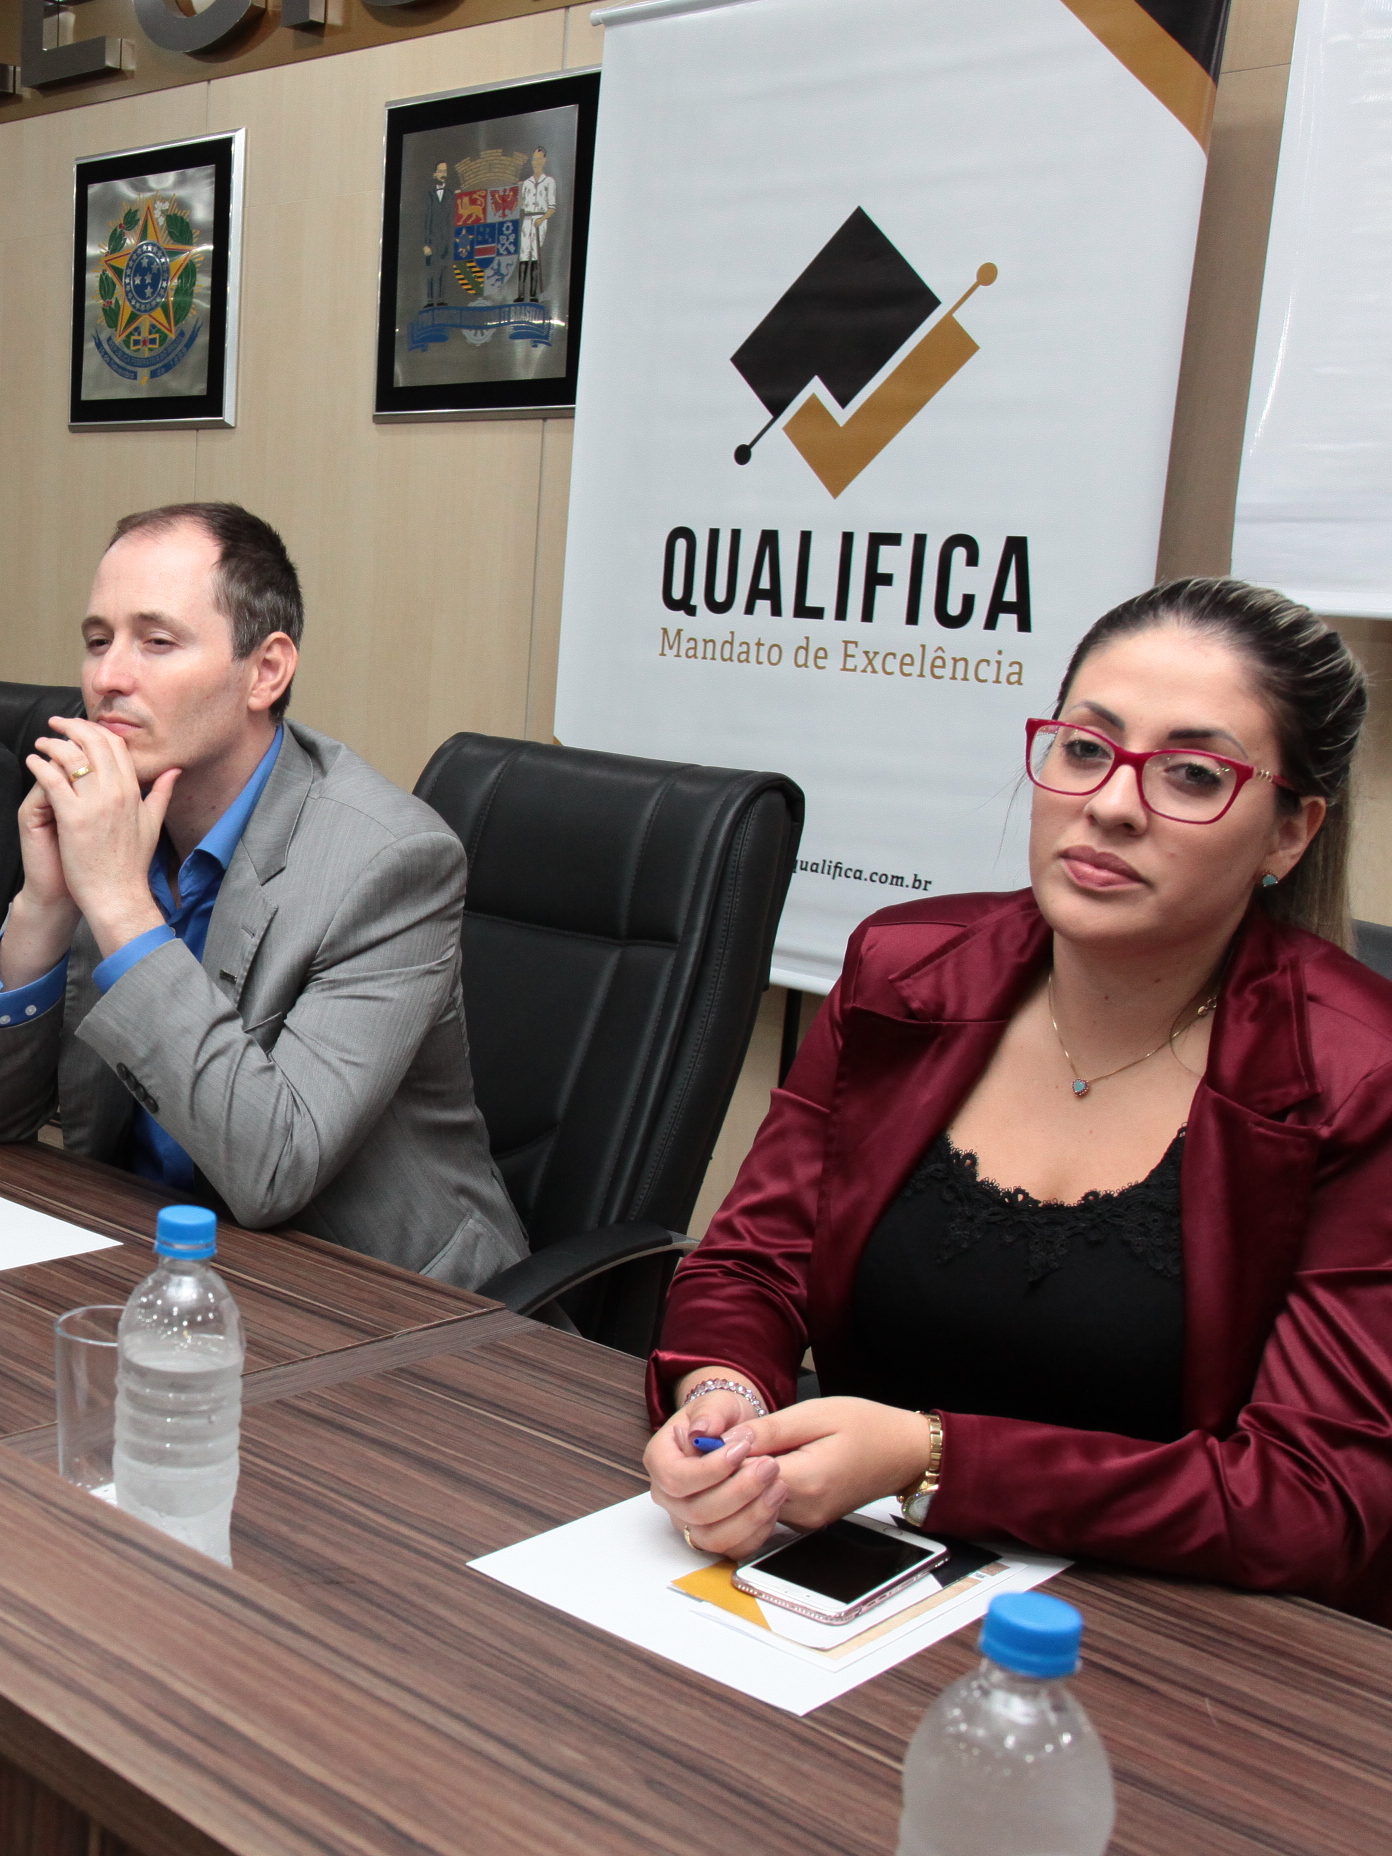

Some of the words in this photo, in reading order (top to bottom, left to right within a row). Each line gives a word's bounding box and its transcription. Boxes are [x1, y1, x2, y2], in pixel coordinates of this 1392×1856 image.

[661, 526, 1033, 633] QUALIFICA
[658, 627, 784, 666] Mandato
[794, 636, 828, 670] de
[840, 640, 1025, 686] Excelência
